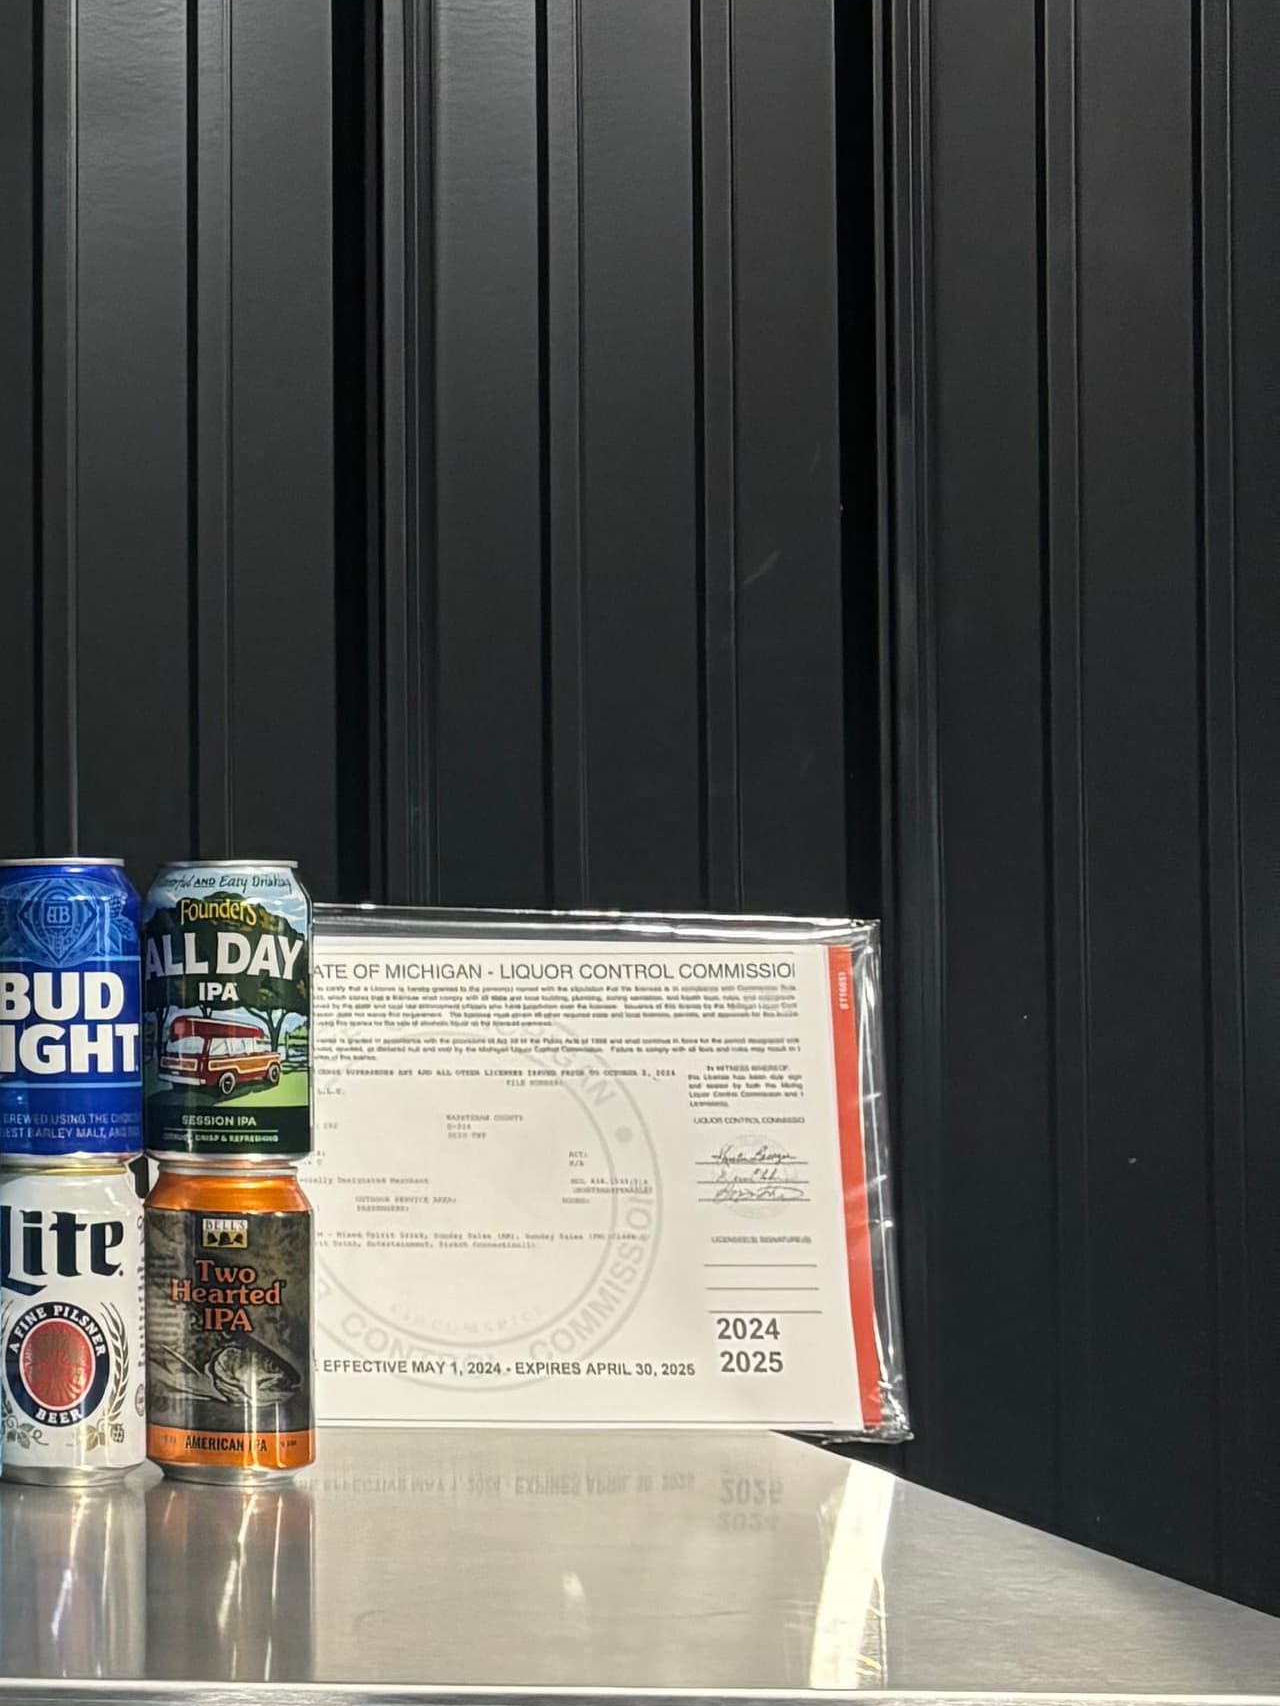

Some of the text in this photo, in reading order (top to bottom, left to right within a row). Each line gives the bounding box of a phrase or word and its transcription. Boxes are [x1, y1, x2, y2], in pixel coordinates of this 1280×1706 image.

[194, 877, 215, 888] AND
[180, 899, 257, 926] Founders
[146, 932, 304, 980] ALL DAY
[353, 964, 379, 980] OF
[385, 964, 482, 980] MICHIGAN
[500, 964, 573, 981] LIQUOR
[579, 963, 674, 979] CONTROL
[678, 962, 796, 979] COMMISSIO
[198, 982, 239, 1001] IPA
[51, 1113, 86, 1125] USING
[88, 1113, 109, 1124] THE
[182, 1115, 256, 1126] SESSION IPA
[0, 1205, 124, 1297] Lite
[195, 1259, 256, 1283] Two
[169, 1278, 281, 1305] Hearted
[12, 1304, 107, 1357] A FINE PILSNER
[203, 1307, 253, 1332] IPA
[716, 1318, 781, 1341] 2024
[323, 1359, 696, 1379] EFFECTIVE MAY 1, 2024 EXPIRES APRIL 30, 2025
[720, 1351, 784, 1374] 2025
[34, 1407, 84, 1426] BEER
[185, 1436, 245, 1452] AMERICAN
